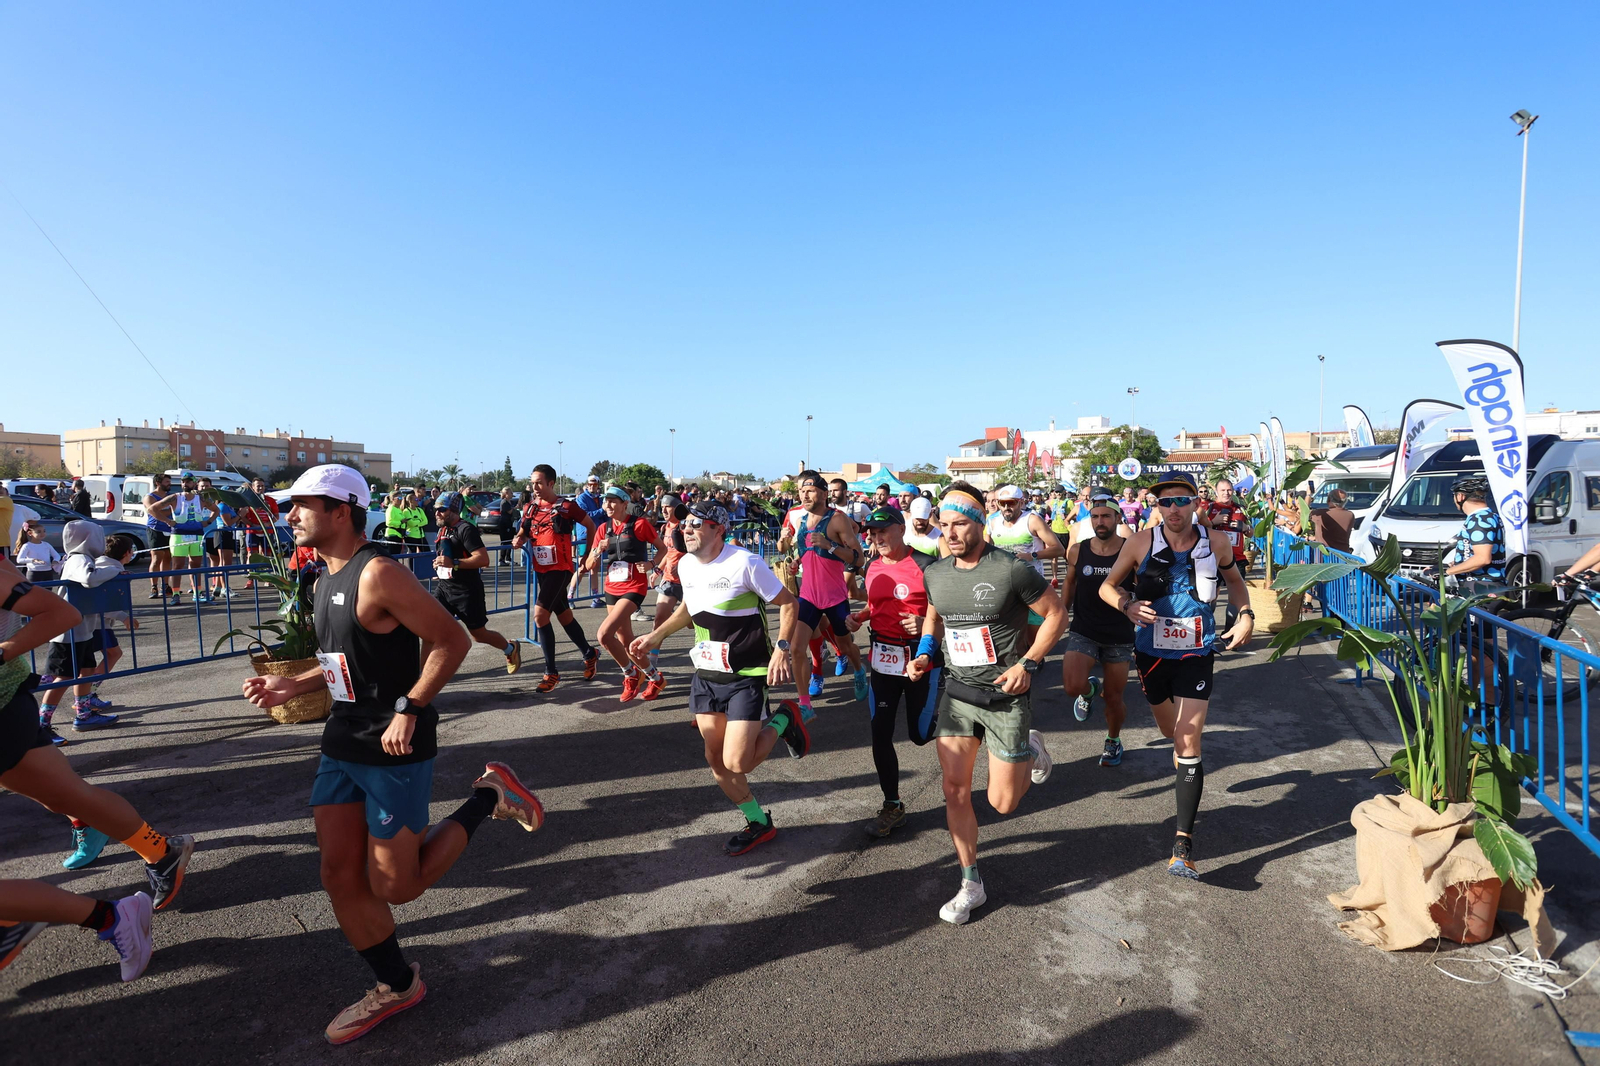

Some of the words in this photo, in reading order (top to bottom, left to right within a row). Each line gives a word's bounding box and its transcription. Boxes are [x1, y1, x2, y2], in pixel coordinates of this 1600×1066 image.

[1147, 465, 1171, 473] TRAIL
[1173, 464, 1203, 472] PIRATA
[1163, 628, 1187, 638] 340
[953, 642, 973, 653] 441
[982, 631, 994, 658] PIRATA
[701, 651, 713, 661] 42
[879, 653, 899, 664] 220
